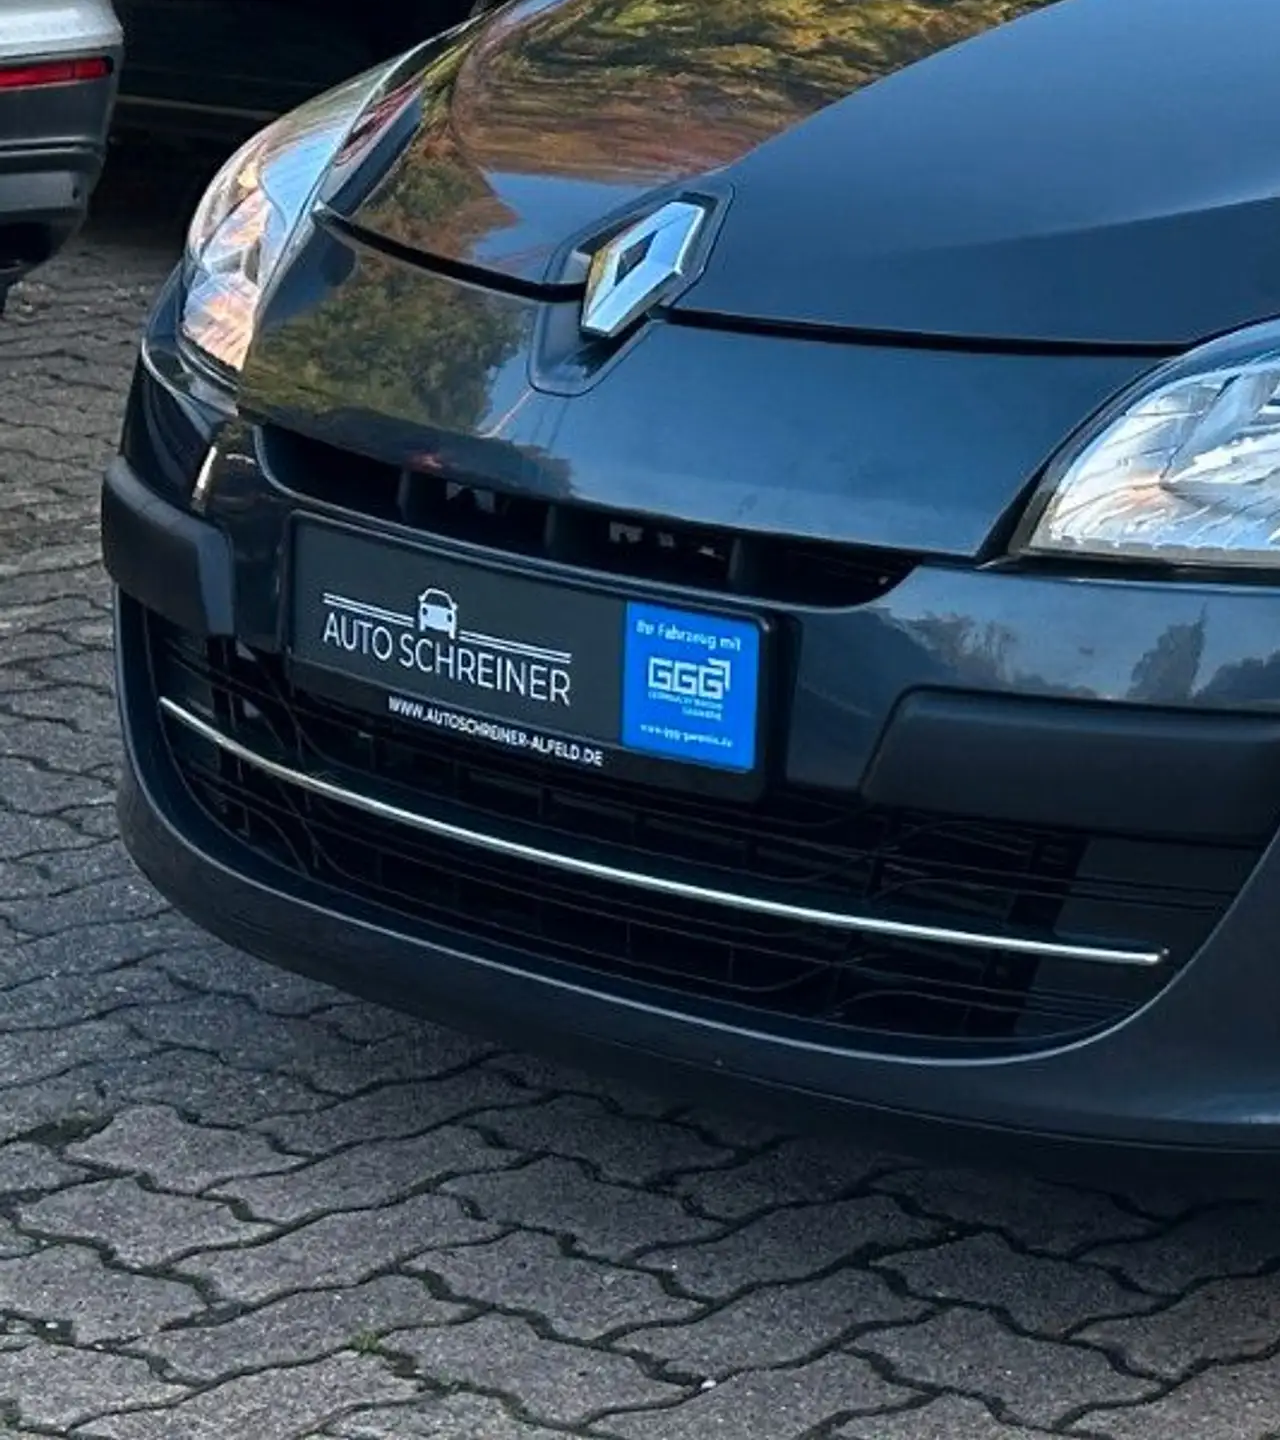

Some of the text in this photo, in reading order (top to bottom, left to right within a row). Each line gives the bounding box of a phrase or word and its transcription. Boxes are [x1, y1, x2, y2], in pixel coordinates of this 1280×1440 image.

[323, 611, 572, 706] AUTO SCHREINER
[648, 656, 731, 700] GGG
[388, 696, 604, 767] WWW.AUTOSCHREINER-ALFELD.DE
